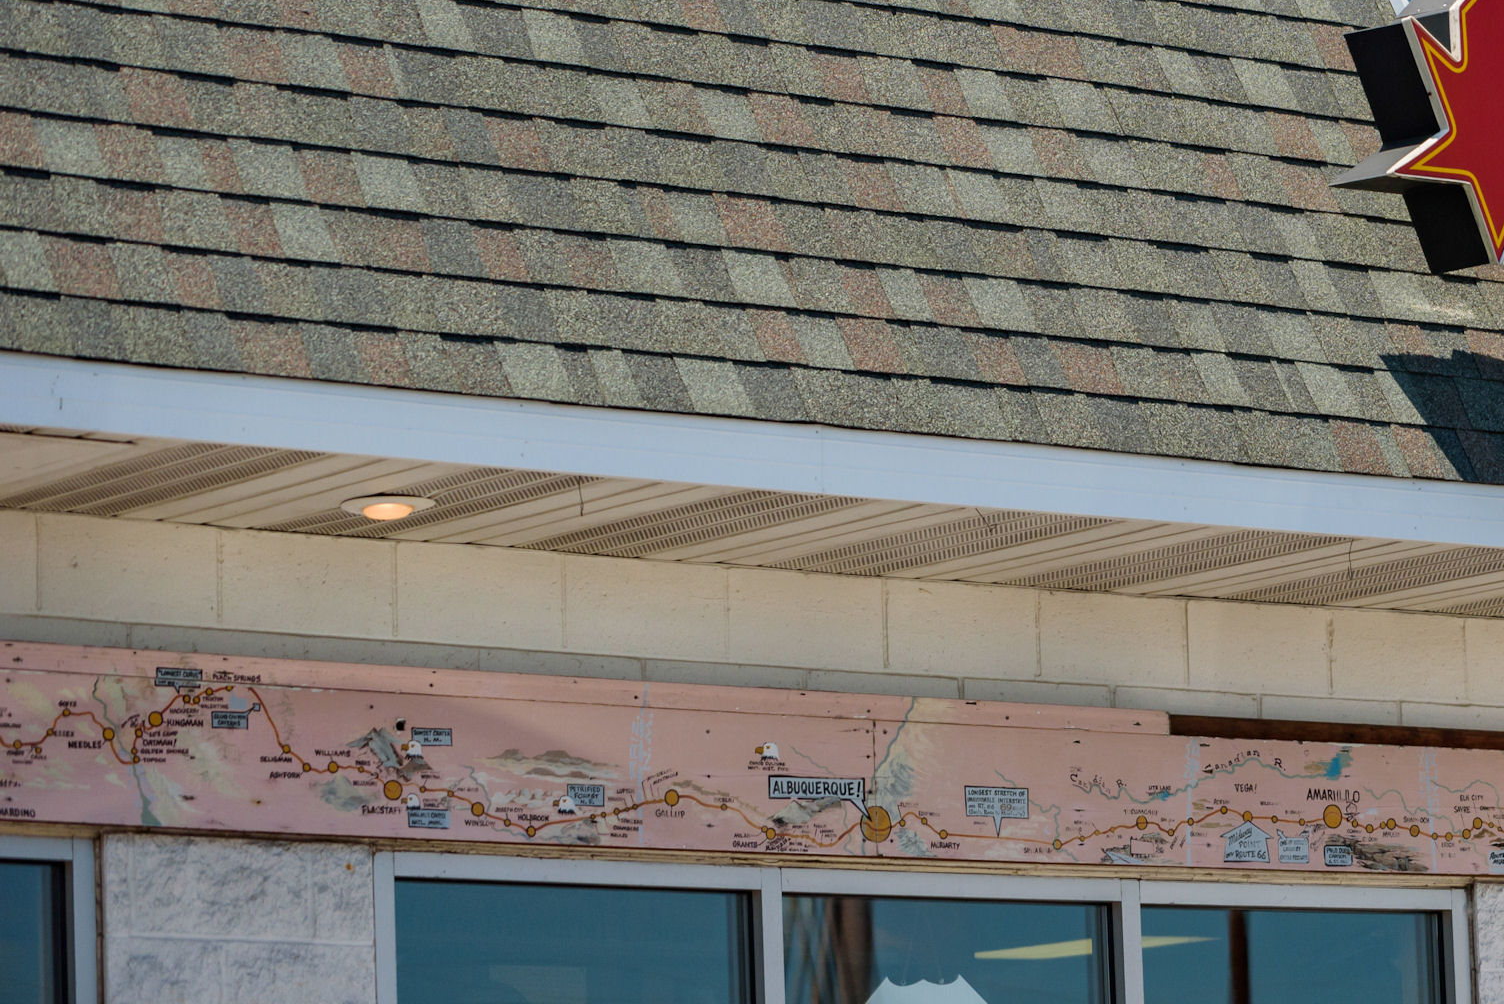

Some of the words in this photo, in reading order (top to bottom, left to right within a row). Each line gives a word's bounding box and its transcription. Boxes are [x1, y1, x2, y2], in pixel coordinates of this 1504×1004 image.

[233, 675, 261, 683] SPRINGS
[167, 719, 204, 727] KINGMAN
[68, 740, 102, 749] NEEDLES
[142, 738, 178, 748] OATMAN!
[314, 749, 351, 757] WILLIAMS
[773, 780, 862, 798] ALBUQUERQUE!
[967, 789, 992, 797] LONGEST
[994, 789, 1017, 797] STRETCH
[1234, 783, 1258, 794] VEGA!
[1306, 787, 1360, 803] AMARILLO
[655, 808, 686, 817] GALLUP
[517, 813, 550, 823] HOLBROOK
[1235, 850, 1256, 859] ROUTE
[1257, 850, 1267, 860] 66
